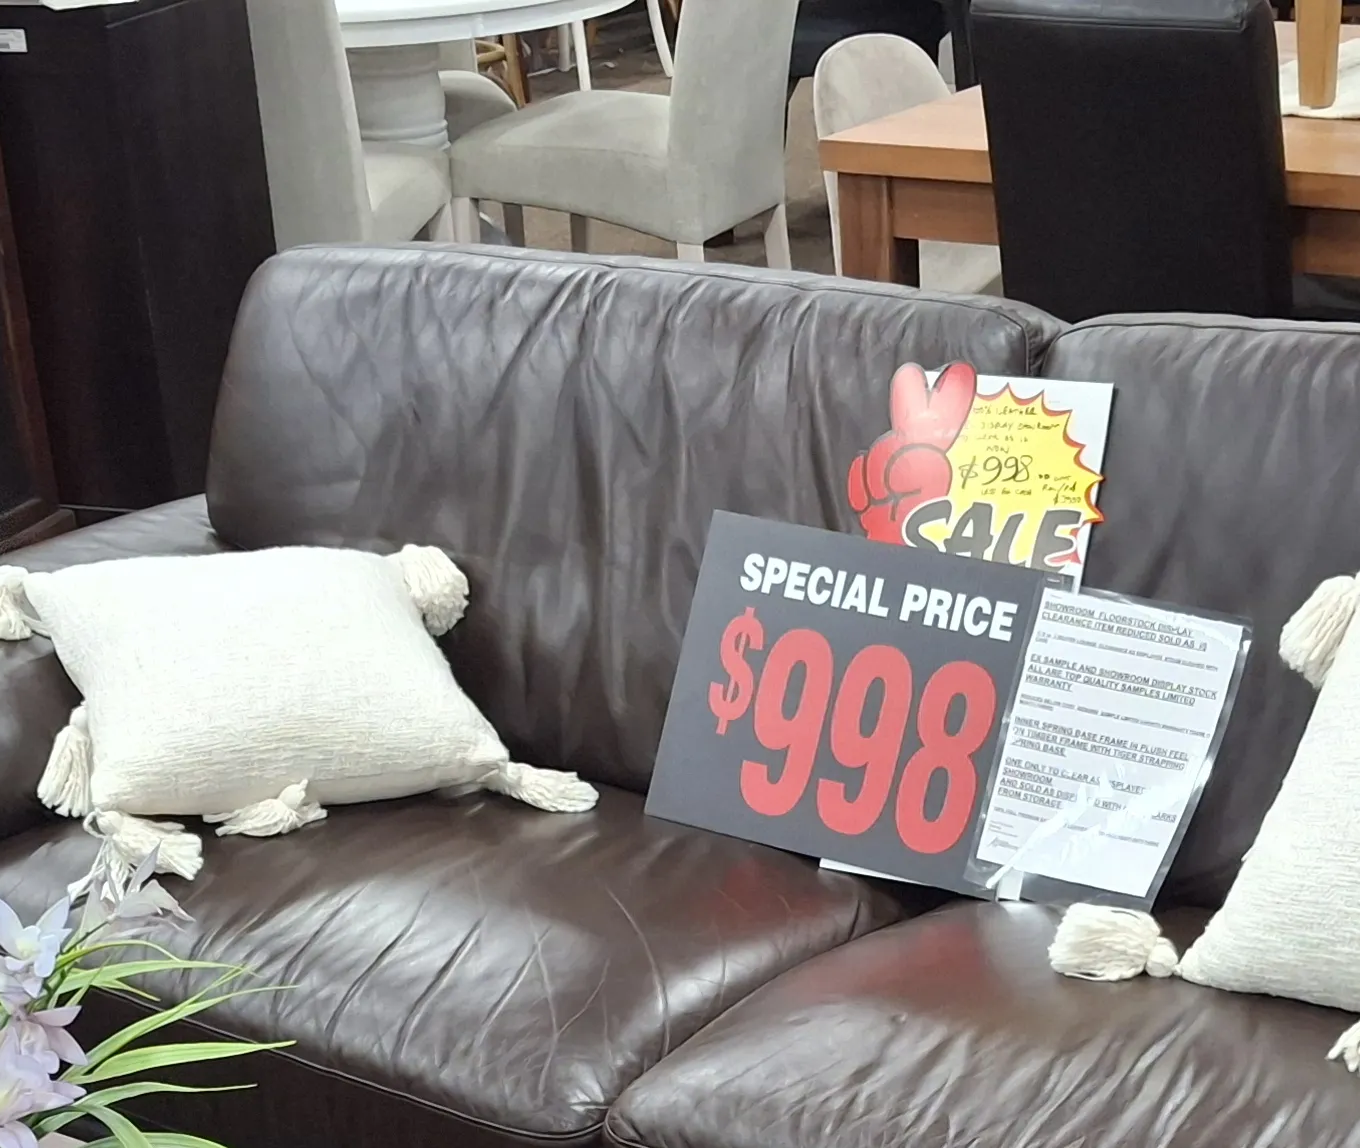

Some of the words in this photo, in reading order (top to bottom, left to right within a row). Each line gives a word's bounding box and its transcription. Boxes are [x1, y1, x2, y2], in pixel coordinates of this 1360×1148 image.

[904, 501, 1082, 574] SALE
[740, 553, 890, 618] SPECIAL
[899, 583, 1020, 641] PRICE
[1041, 611, 1092, 629] CLEARANCE
[1094, 621, 1114, 633] ITEM
[1115, 625, 1157, 642] REDUCED
[1158, 634, 1182, 648] SOLD
[1183, 639, 1195, 650] AS
[1044, 601, 1095, 618] SHOWROOM
[1098, 611, 1156, 630] FLOORSTOCK
[1158, 623, 1194, 638] DISPLAY
[1025, 674, 1073, 693] WARRANTY
[1028, 664, 1044, 675] ALL
[1045, 667, 1063, 679] ARE
[1065, 671, 1082, 683] TOP
[1083, 675, 1120, 691] QUALITY
[1121, 683, 1161, 699] SAMPLES
[1162, 691, 1196, 707] LIMITED
[1044, 655, 1077, 671] SAMPLE
[1079, 663, 1097, 675] AND
[1099, 668, 1150, 686] SHOWROOM
[1152, 678, 1188, 694] DISPLAY
[1189, 686, 1218, 700] STOCK
[708, 606, 997, 854] $998
[1014, 716, 1039, 728] INNER
[1041, 721, 1073, 735] SPRING
[1075, 729, 1097, 742] BASE
[1100, 734, 1128, 747] FRAME
[1140, 744, 1168, 758] PLUSH
[1169, 750, 1189, 762] FEEL
[1005, 757, 1023, 768] ONE
[1024, 761, 1047, 773] ONLY
[1048, 766, 1060, 776] TO
[1027, 729, 1058, 743] TIMBER
[1059, 736, 1089, 750] FRAME
[1089, 743, 1111, 756] WITH
[1113, 749, 1138, 762] TIGER
[1139, 755, 1186, 771] STRAPPING
[1042, 743, 1067, 758] BASE
[1000, 777, 1018, 788] AND
[1020, 782, 1042, 794] SOLD
[1043, 788, 1055, 797] AS
[1002, 767, 1053, 786] SHOWROOM
[997, 787, 1021, 801] FROM
[1023, 792, 1064, 809] STORAGE
